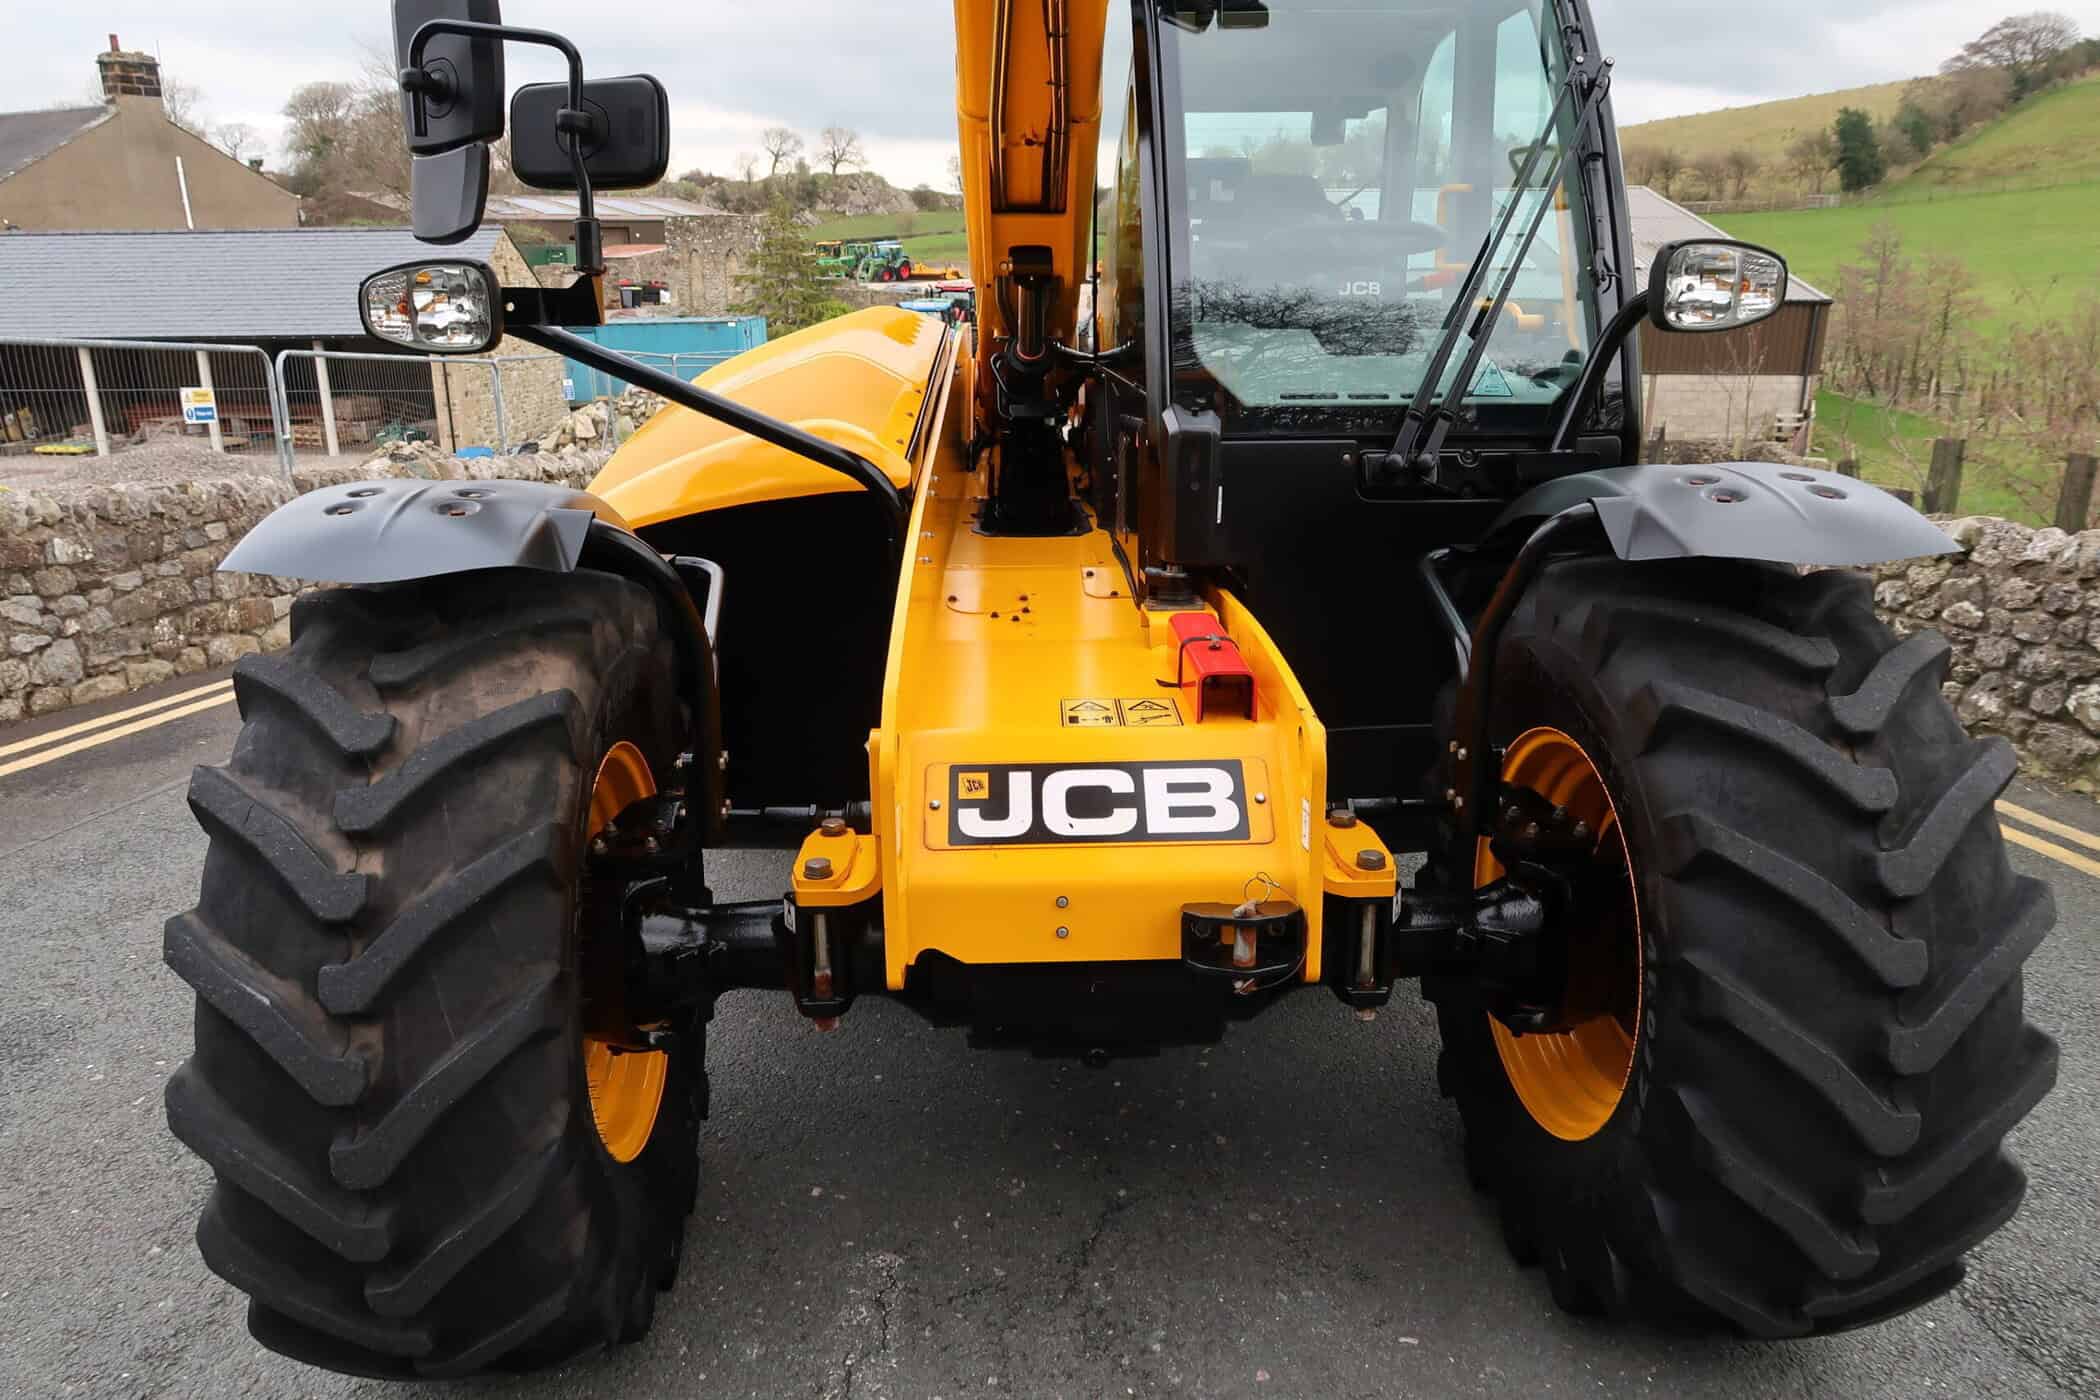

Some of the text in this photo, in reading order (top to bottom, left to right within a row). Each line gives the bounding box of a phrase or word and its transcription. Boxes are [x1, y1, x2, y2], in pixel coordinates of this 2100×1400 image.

[1338, 280, 1381, 296] JCB
[965, 778, 985, 793] JCB
[957, 767, 1240, 838] JCB
